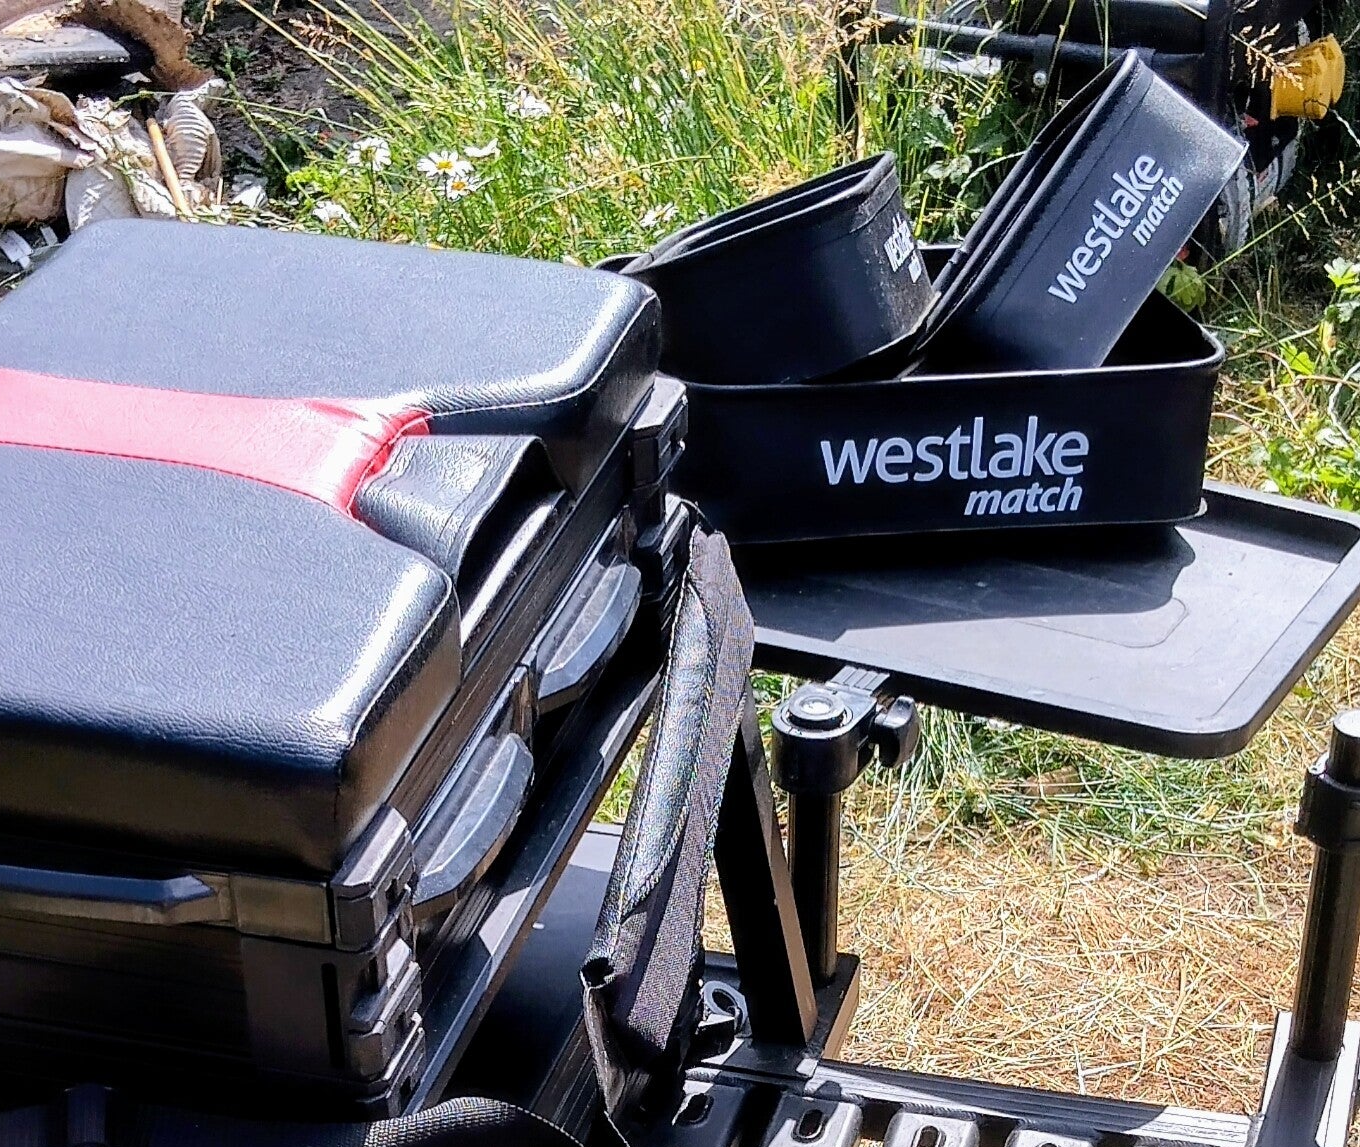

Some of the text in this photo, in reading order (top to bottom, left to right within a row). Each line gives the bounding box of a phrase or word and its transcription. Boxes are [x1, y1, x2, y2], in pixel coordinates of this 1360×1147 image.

[1047, 154, 1164, 304] westlake
[1132, 176, 1184, 247] match
[819, 415, 1090, 486] westlake
[963, 476, 1084, 516] match
